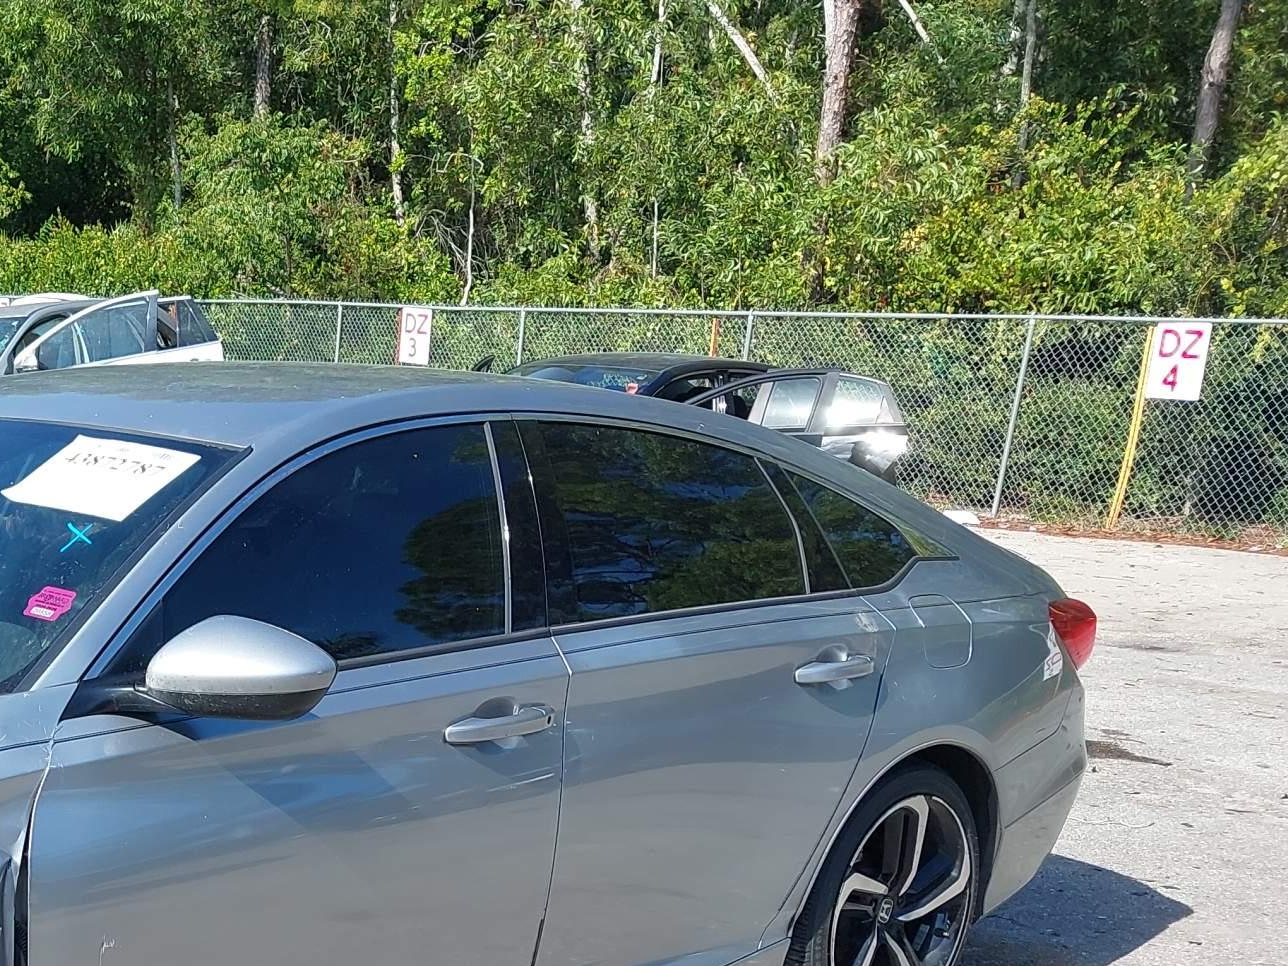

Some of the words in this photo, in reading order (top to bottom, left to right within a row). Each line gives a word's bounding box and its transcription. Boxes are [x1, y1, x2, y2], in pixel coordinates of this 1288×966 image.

[404, 313, 429, 335] DZ
[408, 337, 417, 358] 3
[1158, 329, 1205, 359] DZ
[1161, 363, 1179, 392] 4
